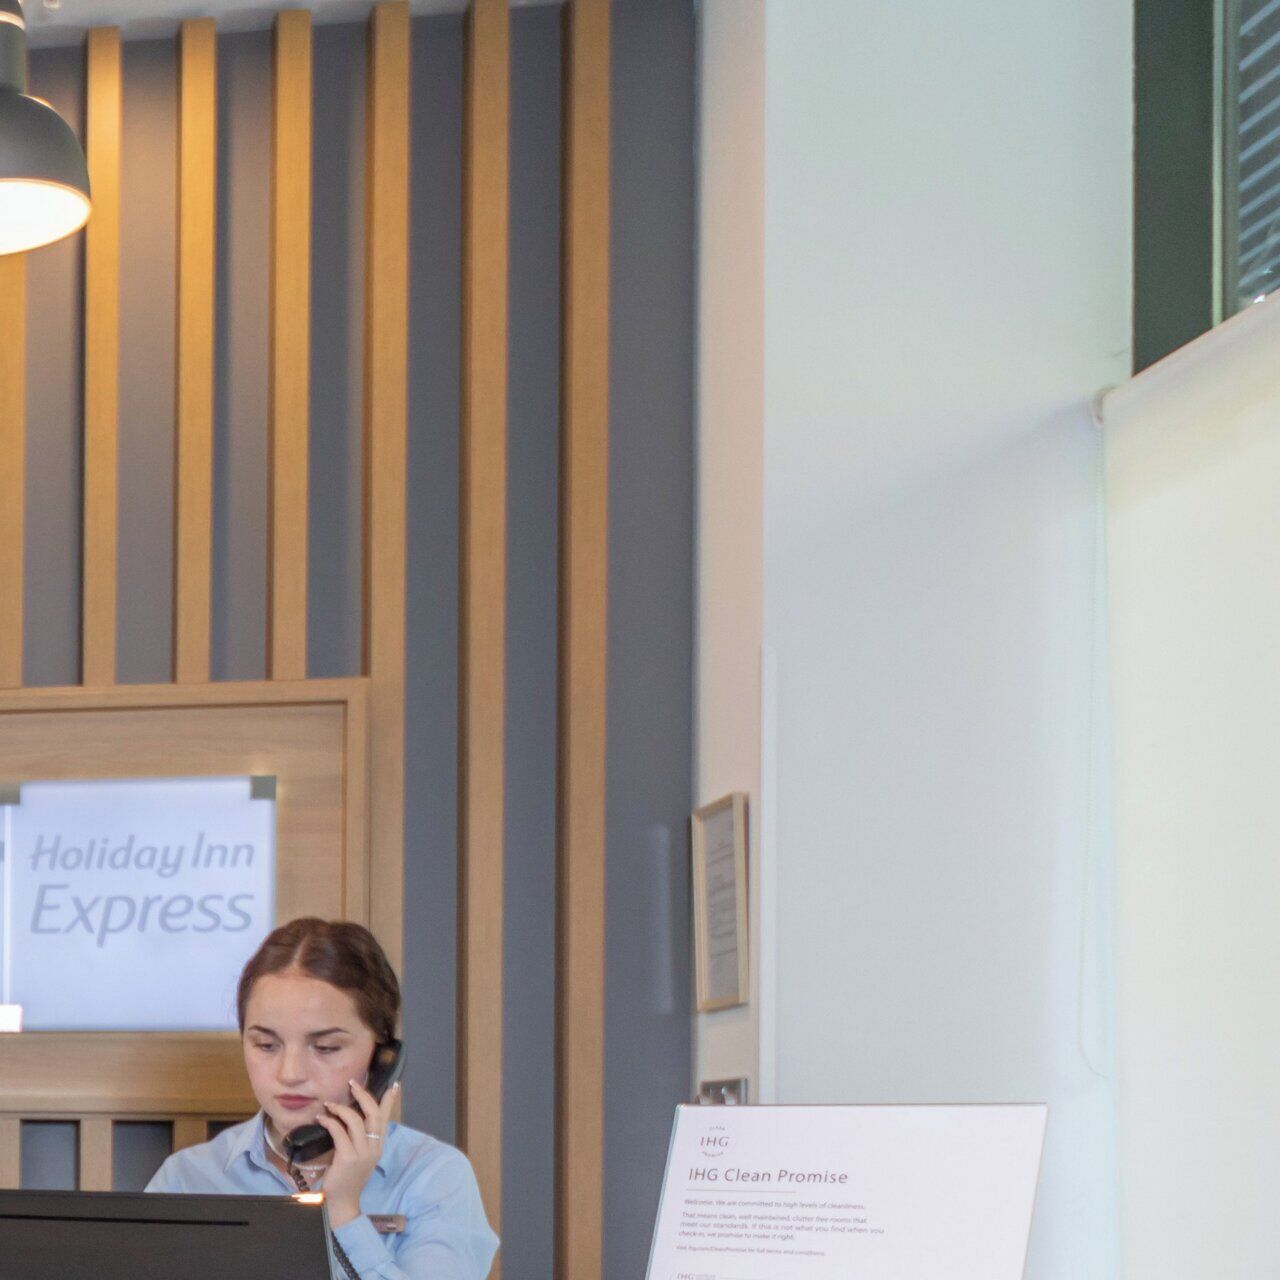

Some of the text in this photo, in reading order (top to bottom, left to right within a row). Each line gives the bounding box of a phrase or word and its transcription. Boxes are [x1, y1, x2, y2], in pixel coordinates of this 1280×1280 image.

[29, 832, 255, 878] Holiday Inn
[29, 883, 256, 948] Express
[701, 1136, 730, 1147] IHG
[689, 1168, 848, 1184] IHG Clean Promise
